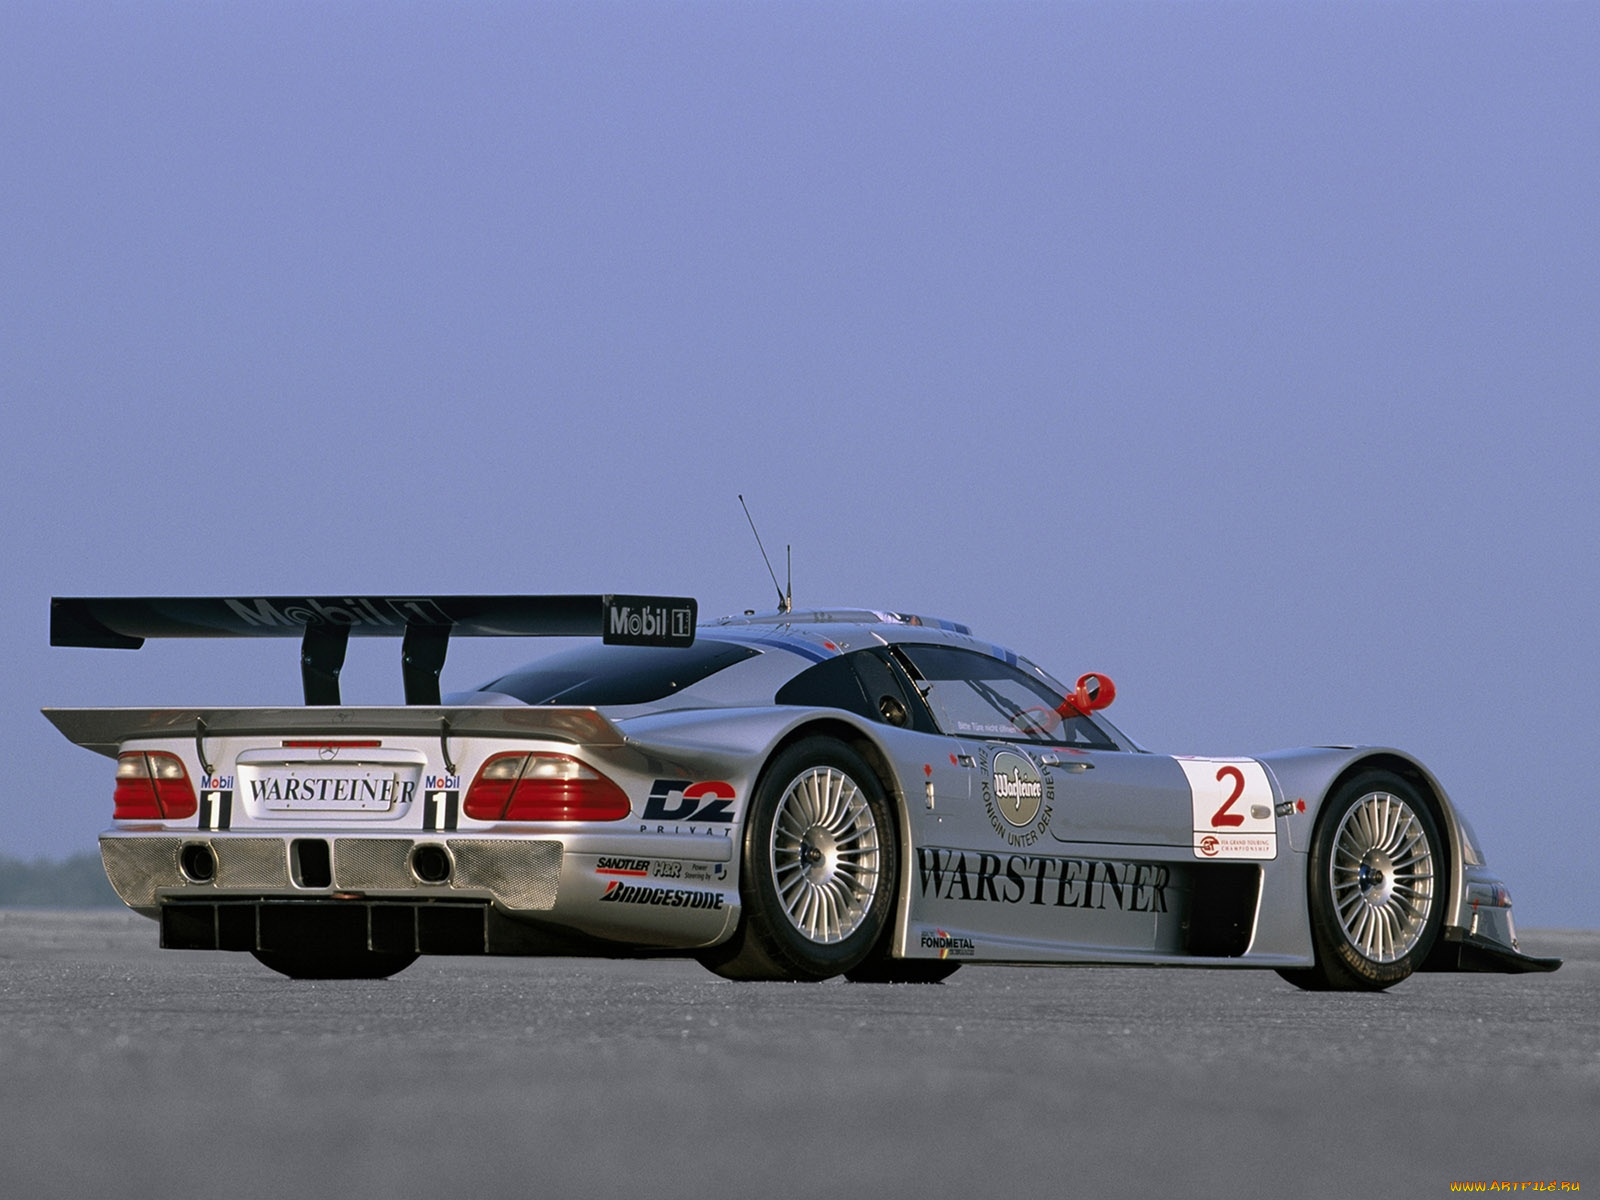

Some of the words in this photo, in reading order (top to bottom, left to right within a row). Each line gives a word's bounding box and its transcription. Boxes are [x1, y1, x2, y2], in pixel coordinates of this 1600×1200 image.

[224, 599, 396, 626] Mobil
[610, 606, 667, 635] Mobil
[201, 776, 234, 789] Mobil
[250, 777, 416, 804] WARSTEINER
[425, 776, 460, 789] Mobil
[1211, 765, 1245, 827] 2
[207, 791, 221, 831] 1
[432, 791, 447, 831] 1
[642, 779, 736, 822] D2
[979, 747, 989, 777] EINE
[1008, 830, 1038, 848] UNTER
[1037, 805, 1053, 834] DEN
[640, 825, 732, 837] PRIVAT
[596, 857, 650, 872] SANDTLER
[653, 861, 682, 878] H&R
[915, 847, 1171, 913] WARSTEINER
[600, 881, 724, 910] BRIDGESTONE
[921, 937, 975, 949] FONDMETAL
